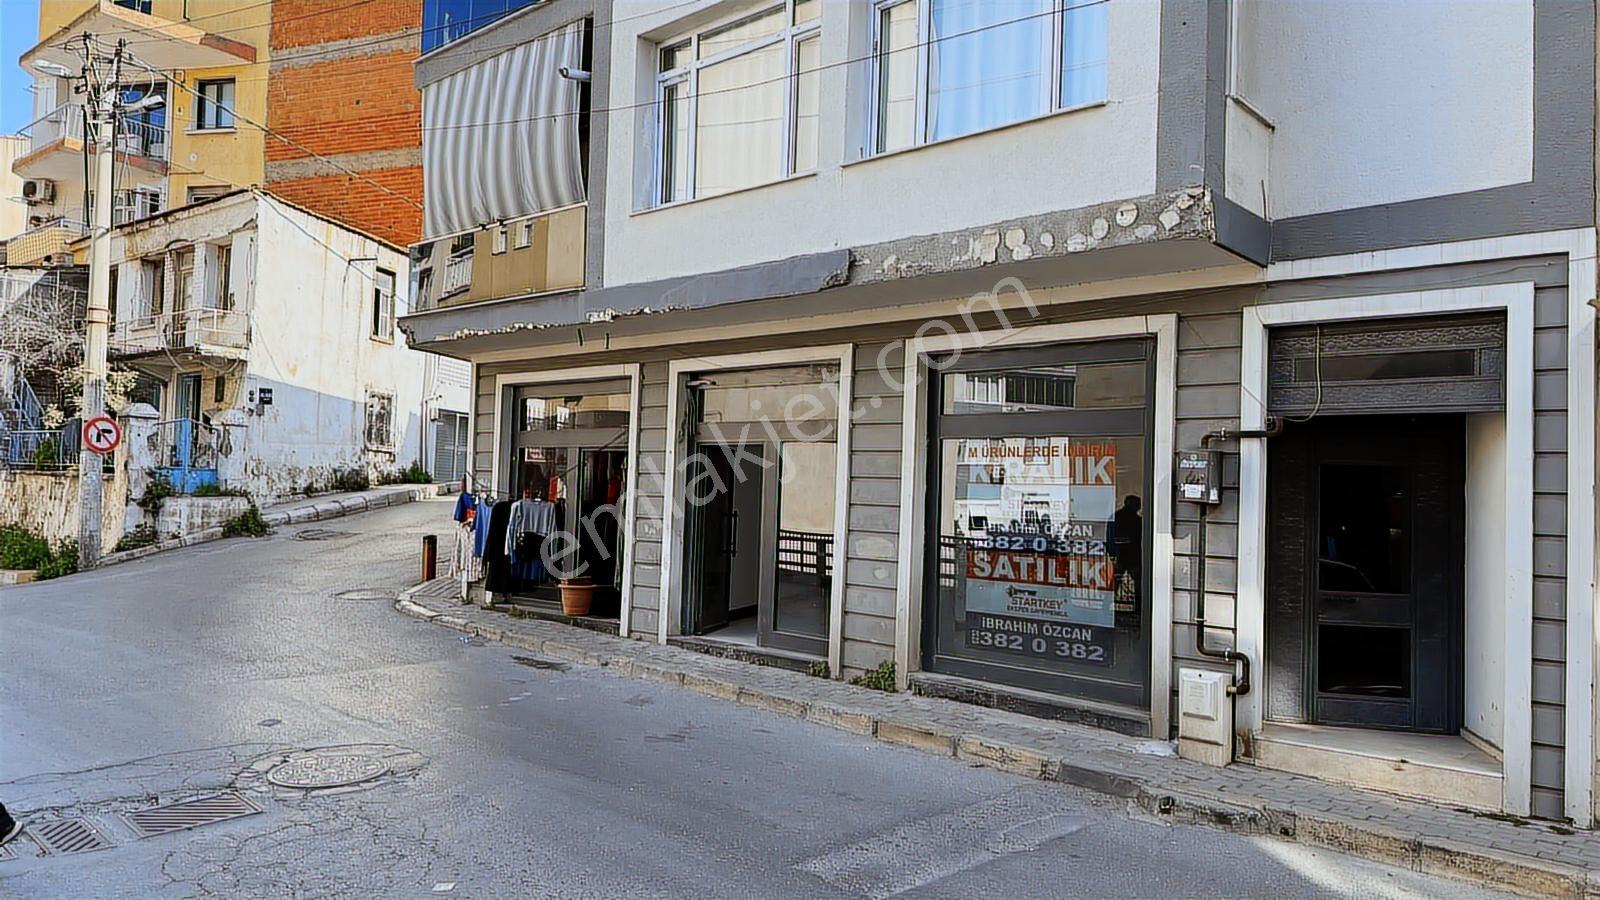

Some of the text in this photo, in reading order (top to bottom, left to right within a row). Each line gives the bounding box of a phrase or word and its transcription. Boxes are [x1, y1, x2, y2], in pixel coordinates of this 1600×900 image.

[969, 457, 1112, 484] KRALIK
[982, 535, 1024, 550] 382
[1033, 537, 1047, 552] 0
[973, 551, 1106, 587] SATILIK
[980, 631, 1023, 650] 382
[1032, 638, 1047, 653] 0
[1055, 641, 1104, 661] 382
